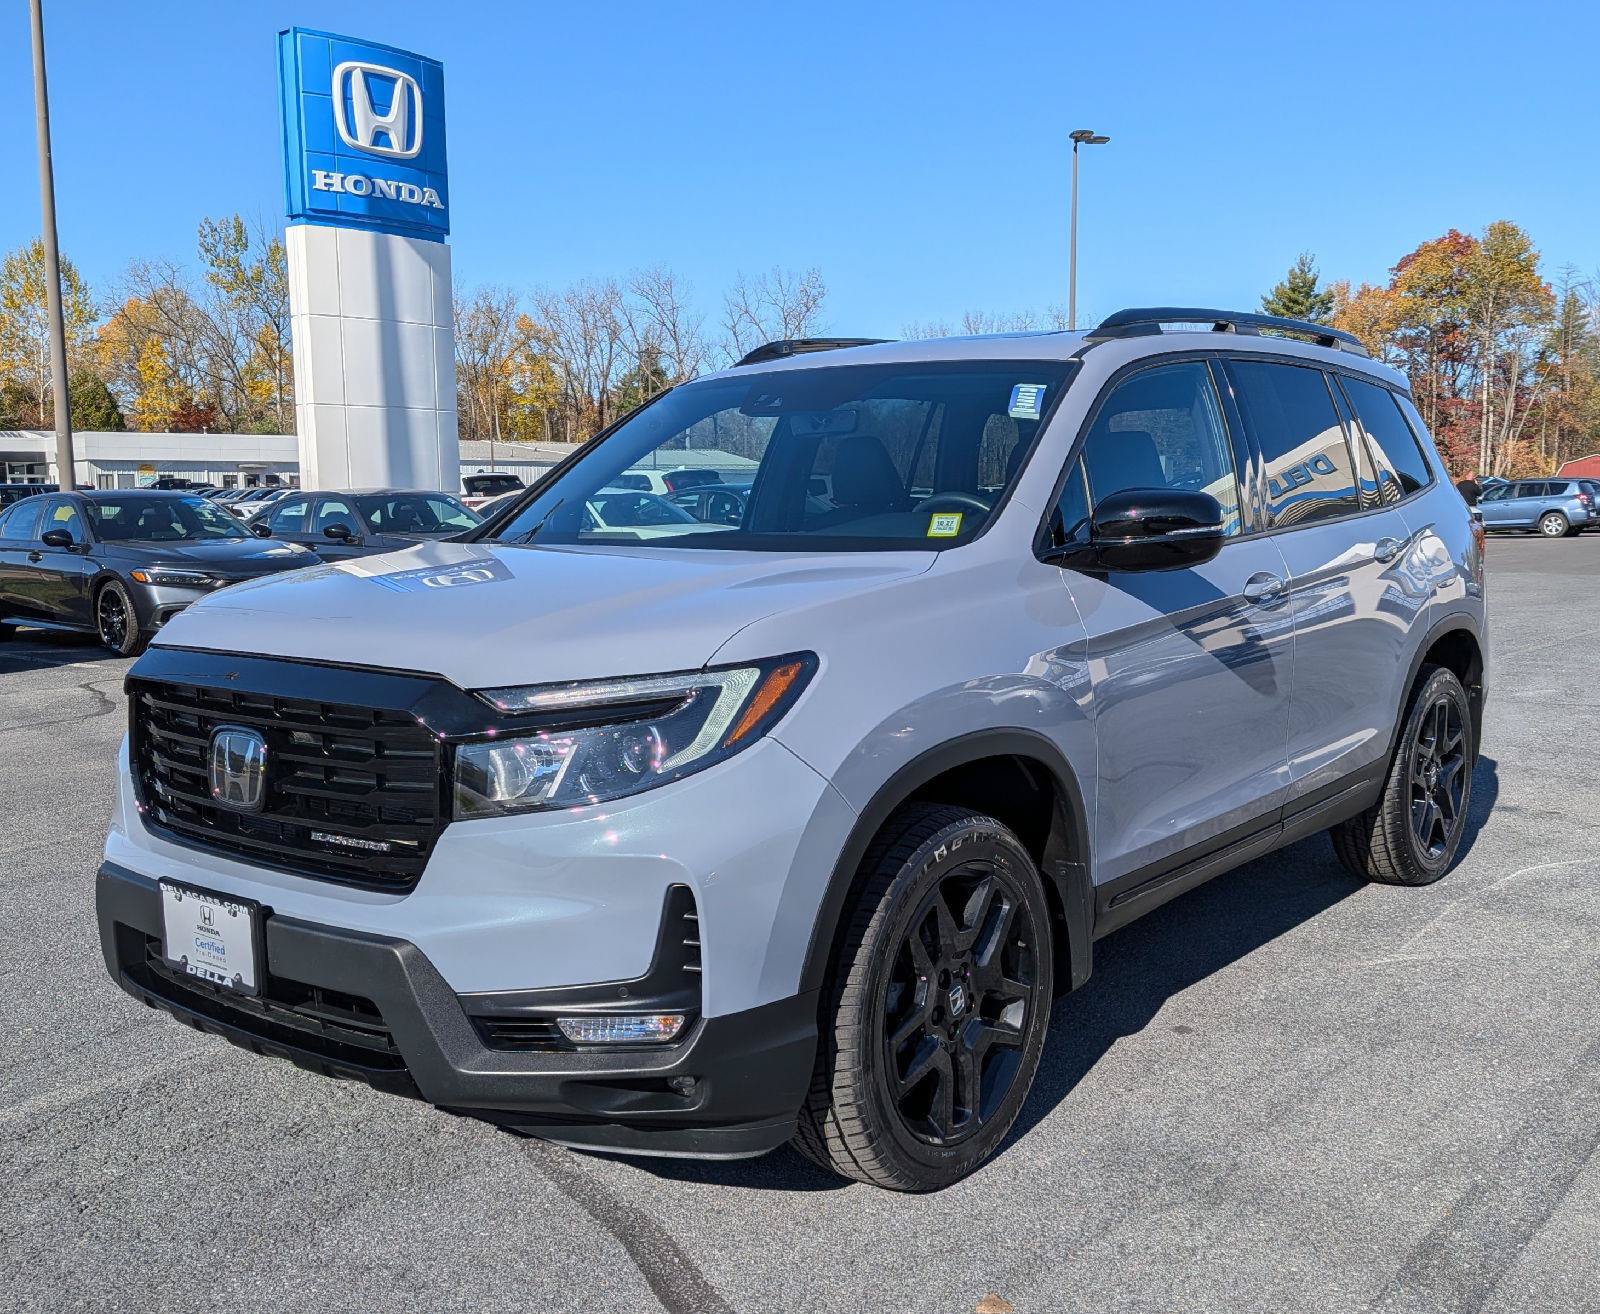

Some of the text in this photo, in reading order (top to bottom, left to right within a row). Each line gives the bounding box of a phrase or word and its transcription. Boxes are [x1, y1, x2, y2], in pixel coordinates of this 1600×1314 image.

[311, 169, 445, 209] HONDA
[195, 938, 225, 955] Certified
[186, 964, 233, 988] DELLA
